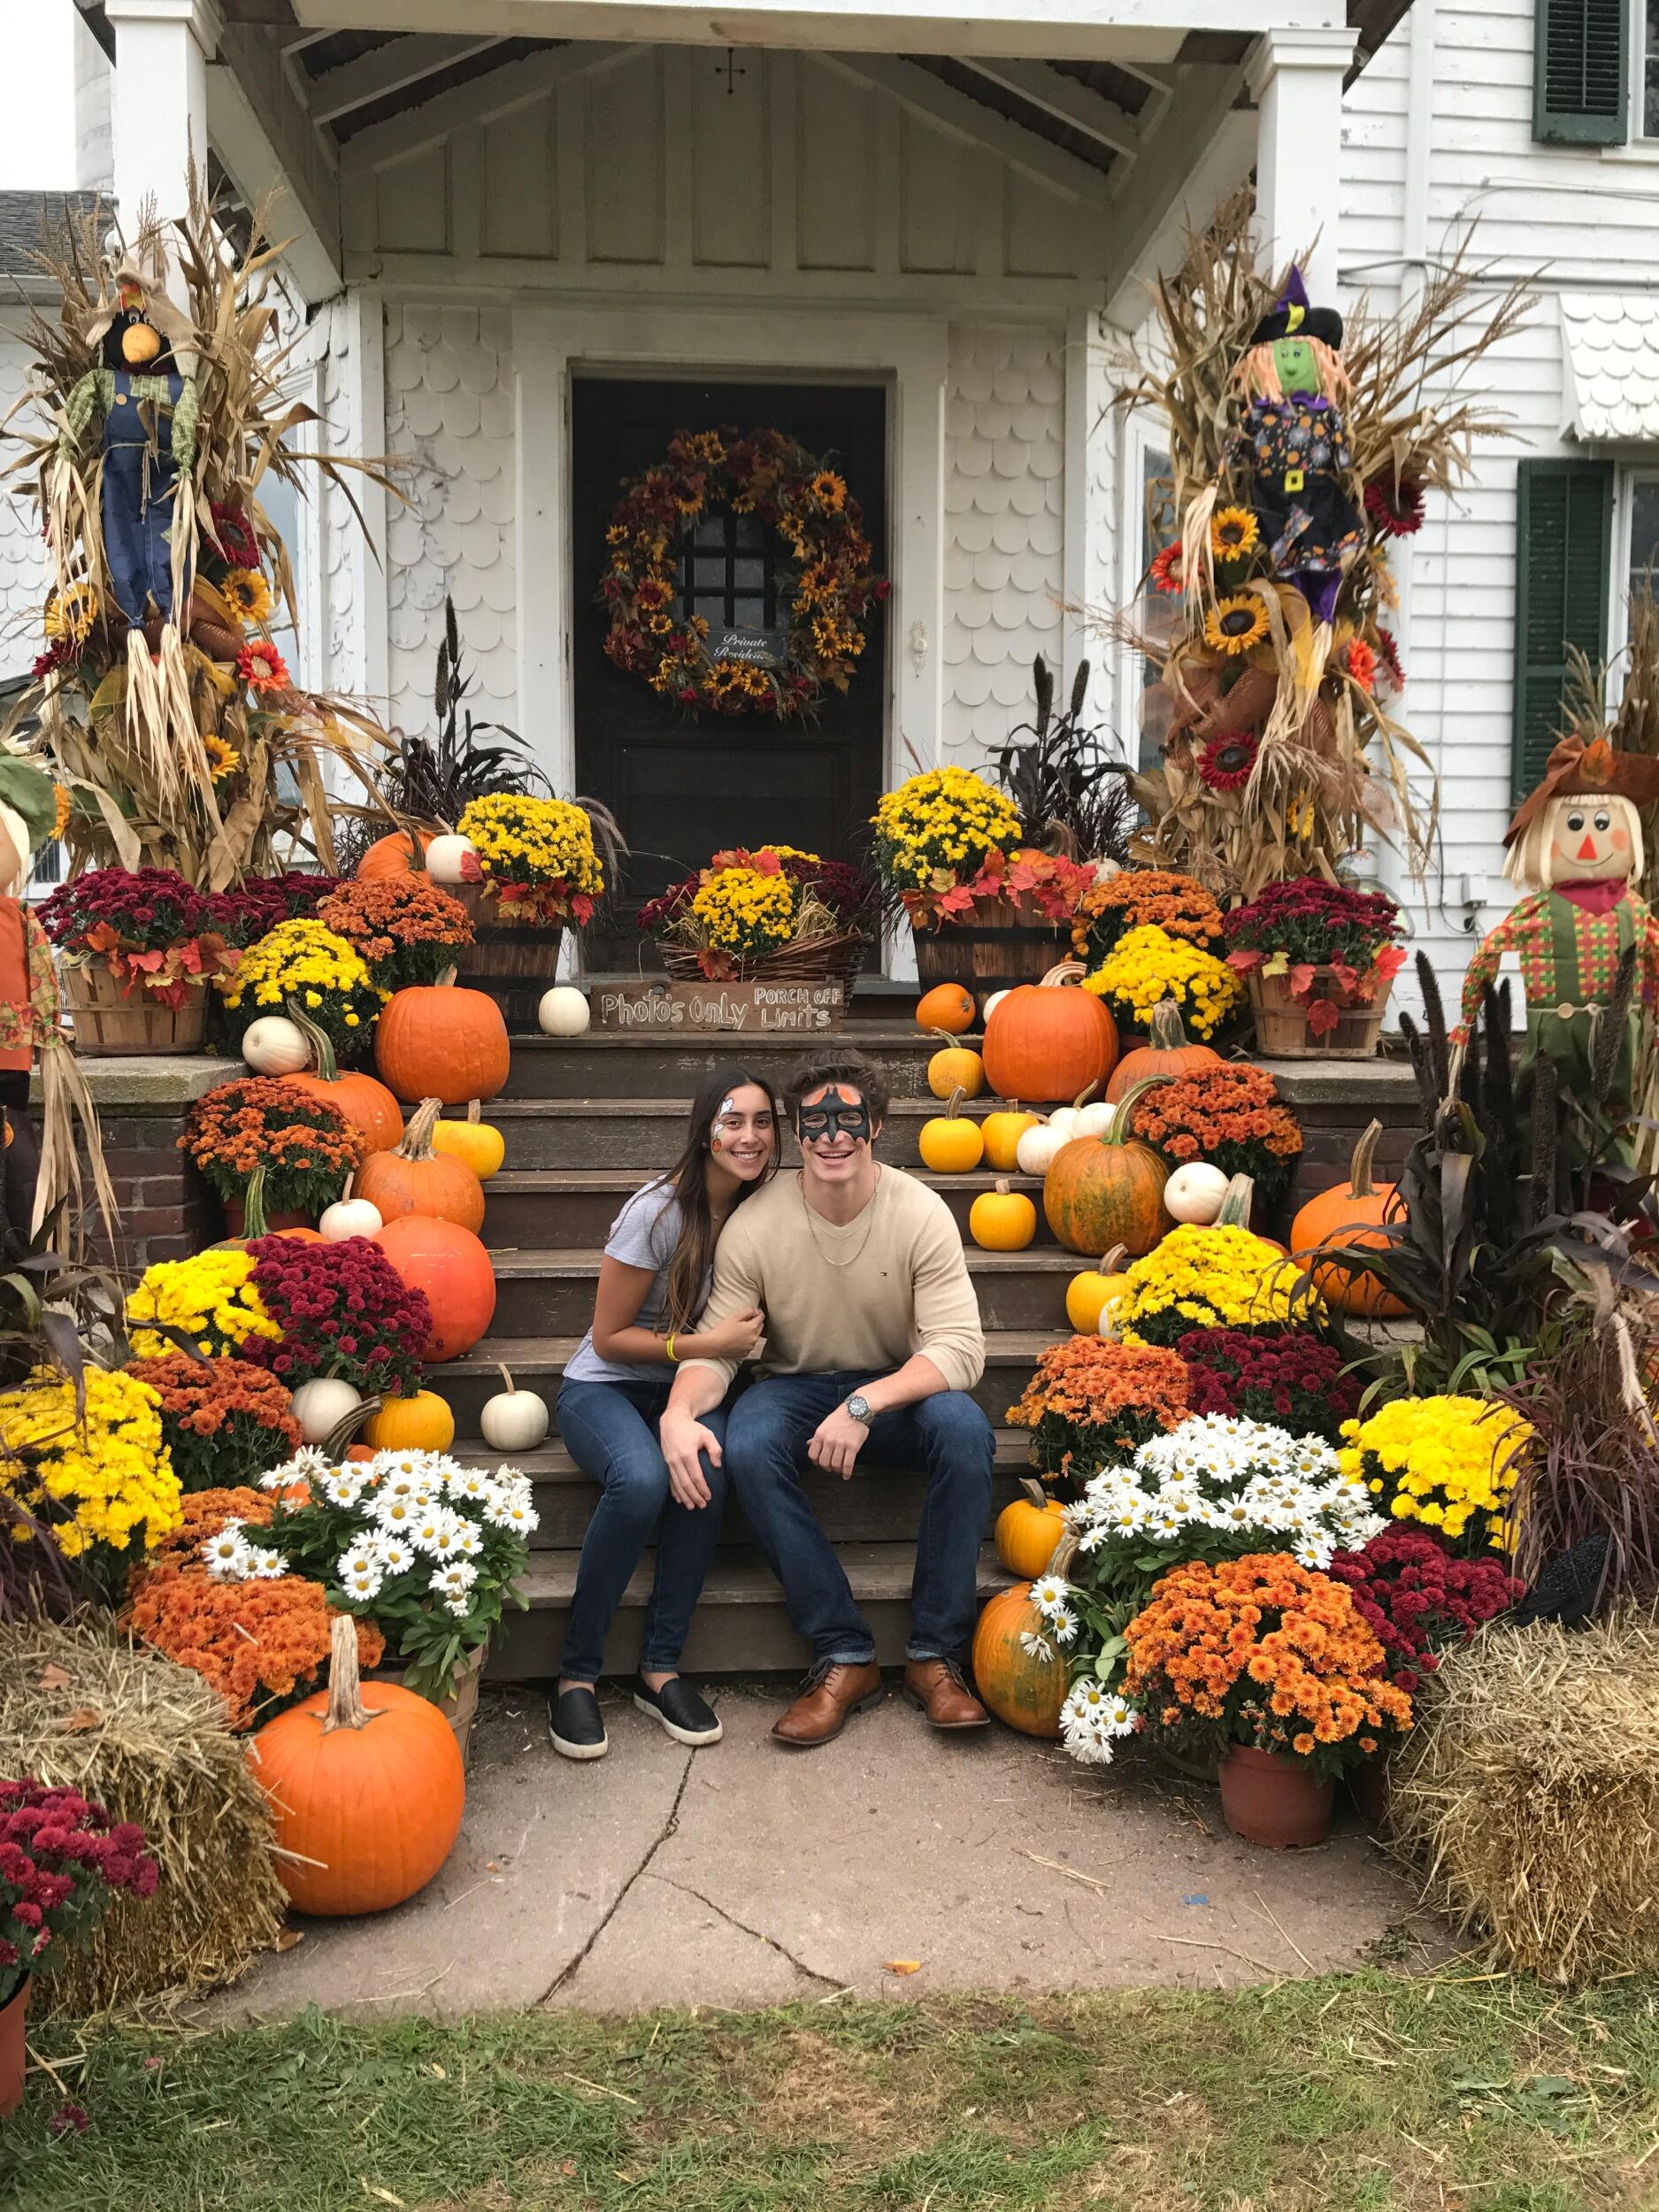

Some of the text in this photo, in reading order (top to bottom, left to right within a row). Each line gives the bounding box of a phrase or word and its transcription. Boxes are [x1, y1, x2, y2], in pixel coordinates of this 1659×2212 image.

[722, 634, 767, 647] Private
[755, 987, 843, 1005] PORCH OFF
